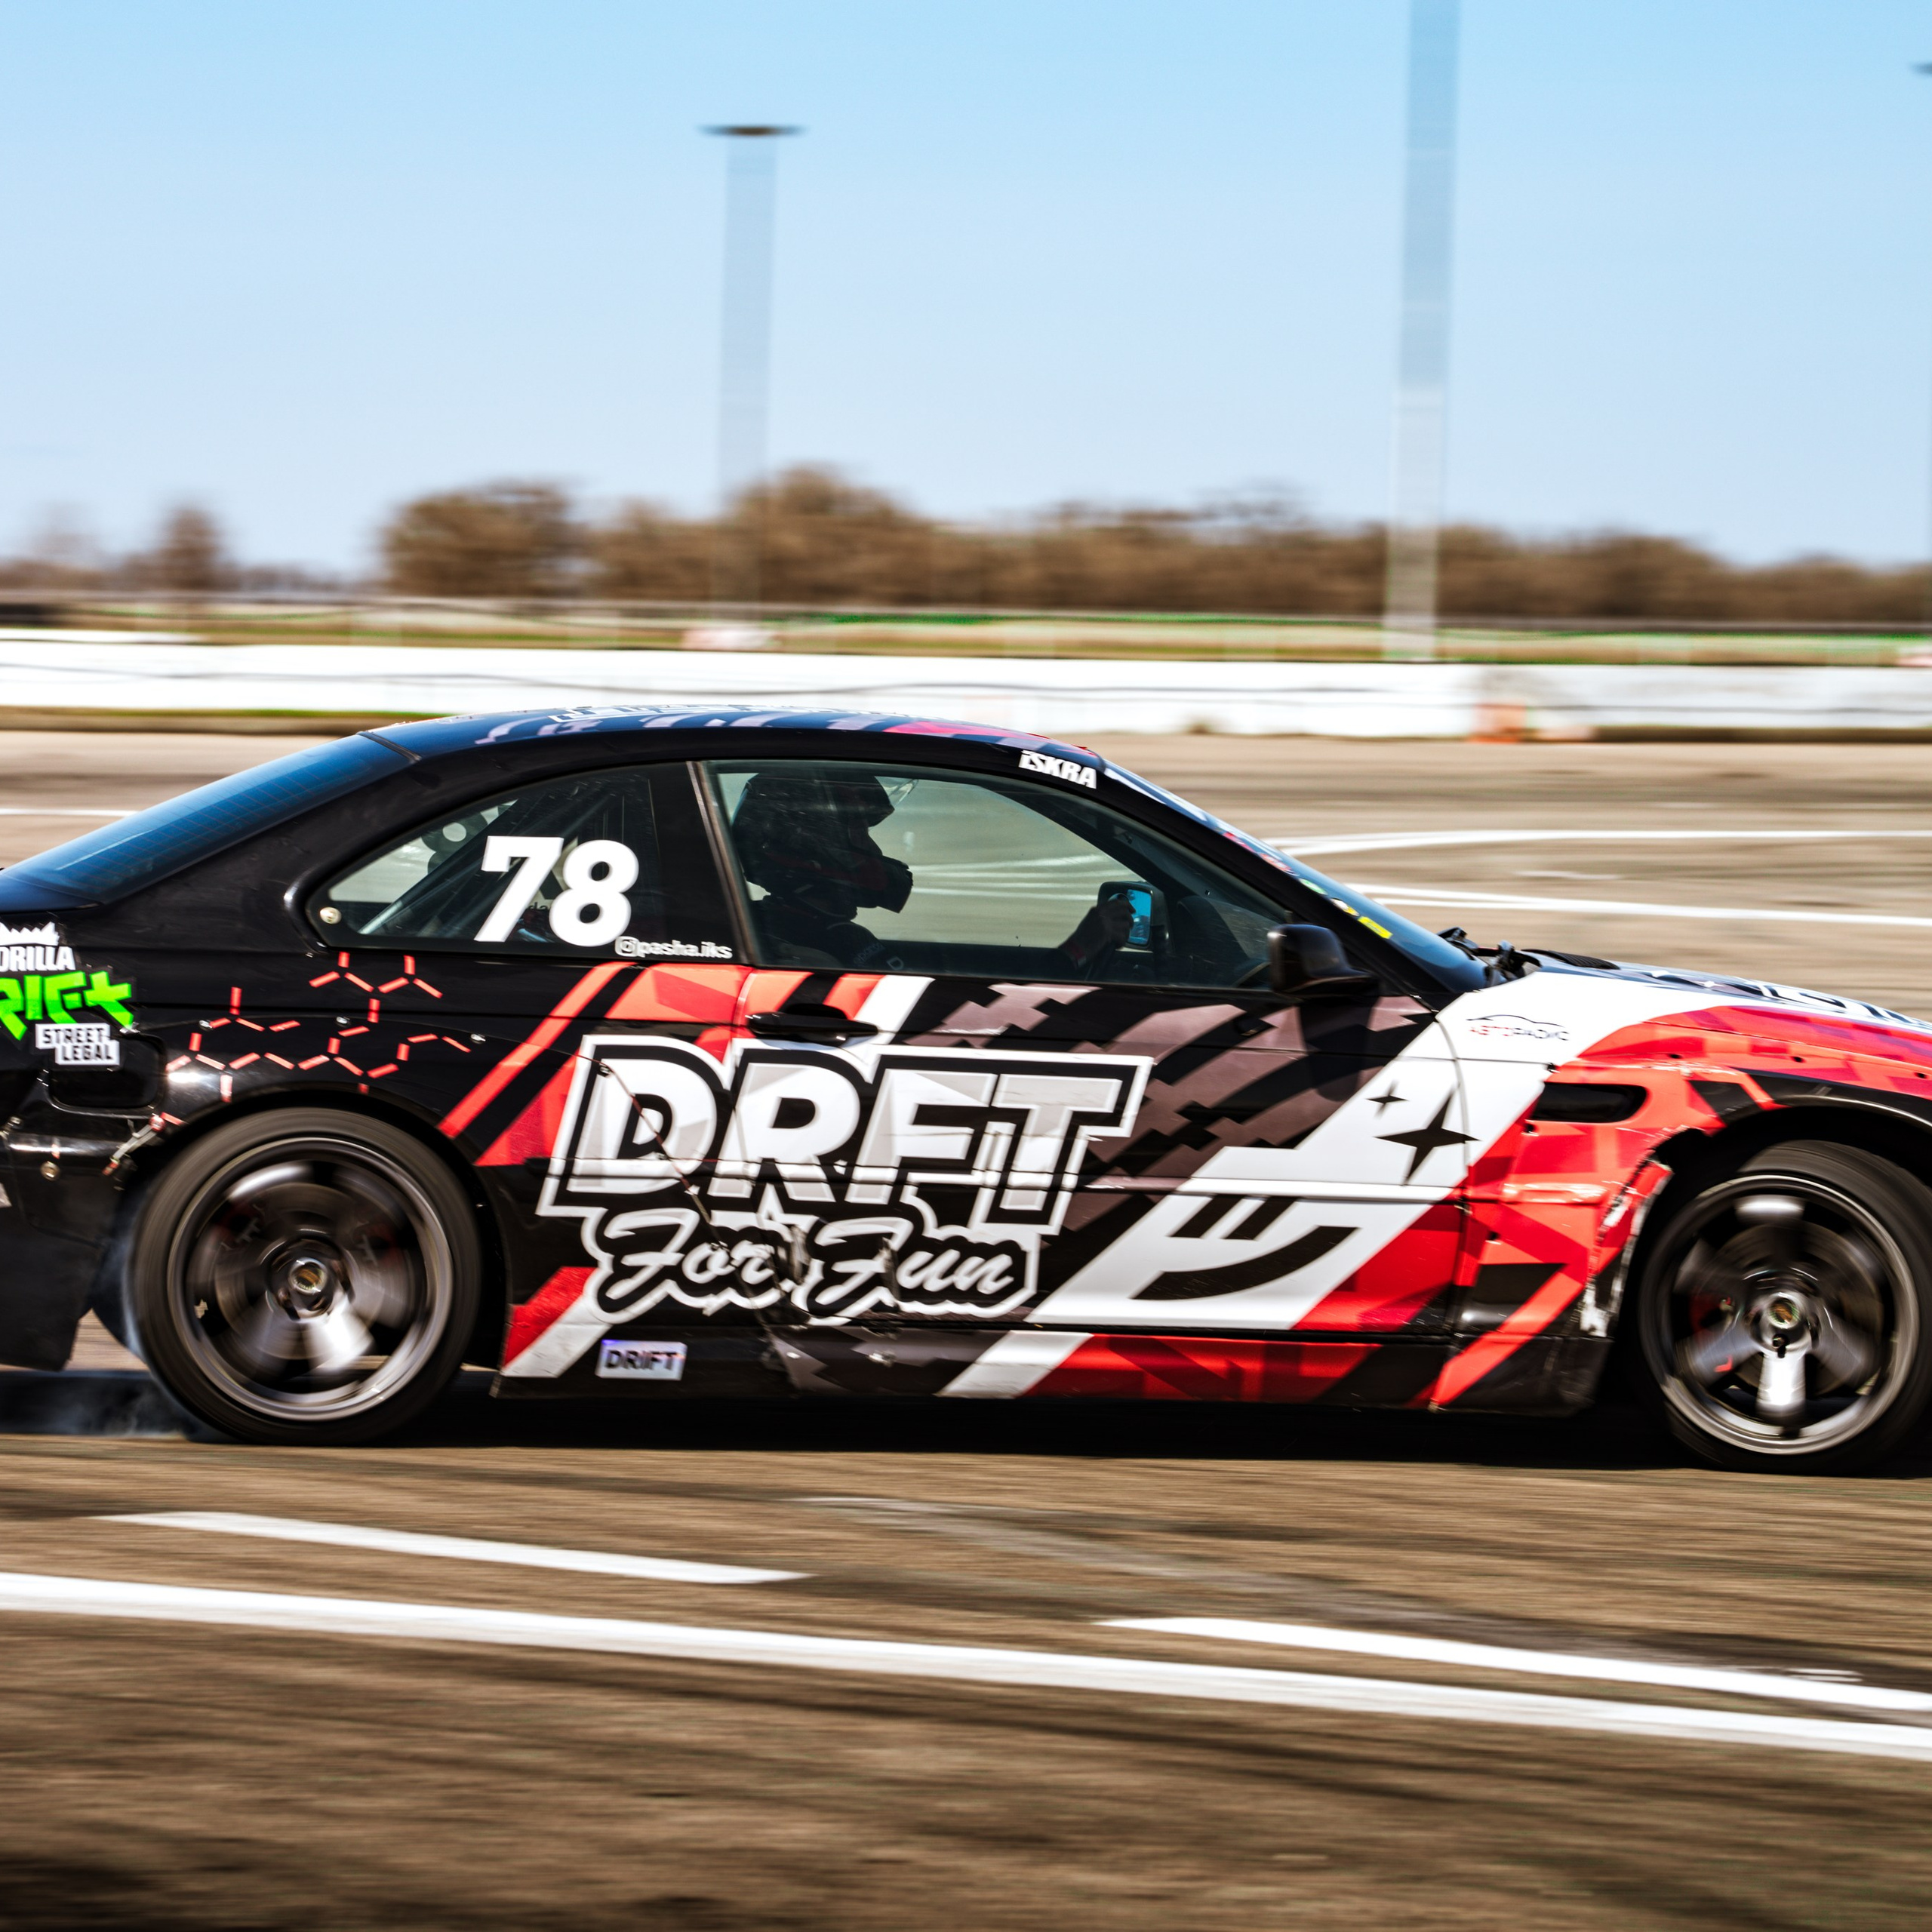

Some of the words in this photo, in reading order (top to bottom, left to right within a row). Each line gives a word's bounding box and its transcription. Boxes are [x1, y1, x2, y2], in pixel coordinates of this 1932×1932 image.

[473, 835, 639, 947] 78
[615, 936, 733, 959] @pasha.iks
[42, 1027, 107, 1044] STREET
[61, 1044, 114, 1061] LEGAL
[603, 1208, 772, 1300] For
[813, 1216, 1016, 1304] Fun
[605, 1350, 678, 1371] DRIFT
